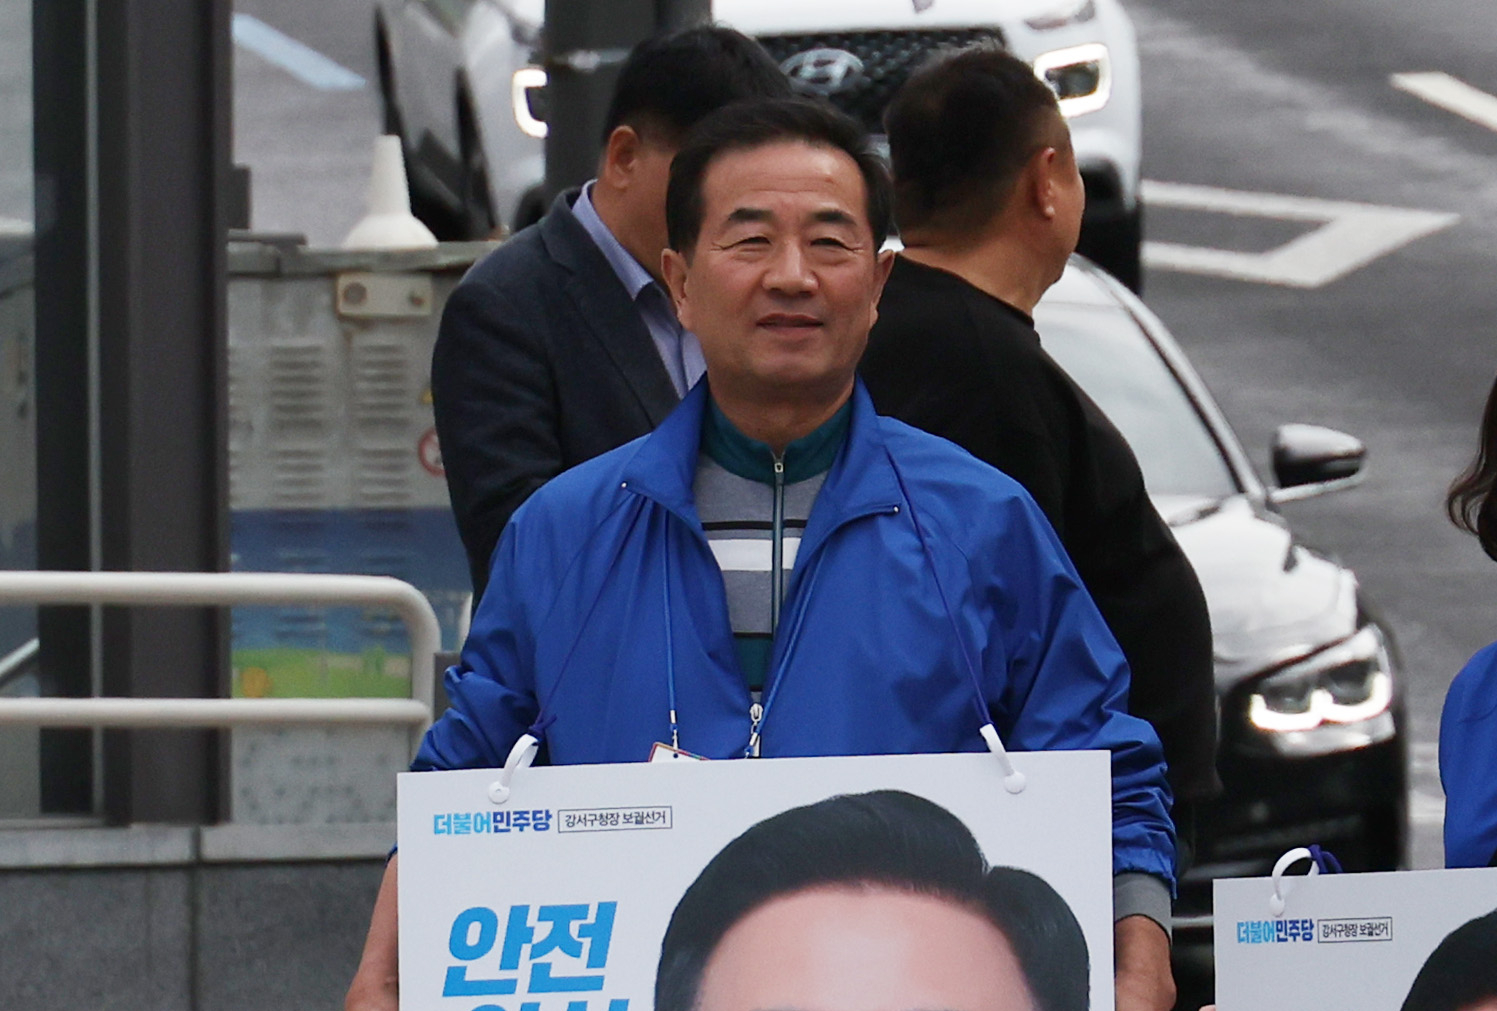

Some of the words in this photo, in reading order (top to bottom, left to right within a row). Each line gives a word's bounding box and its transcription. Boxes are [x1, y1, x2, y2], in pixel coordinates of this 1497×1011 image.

[433, 809, 552, 835] 더불어민주당
[565, 811, 620, 828] 강서구청장
[622, 810, 666, 825] 보궐선거
[1237, 919, 1314, 944] 더불어민주당
[441, 901, 617, 998] 안전
